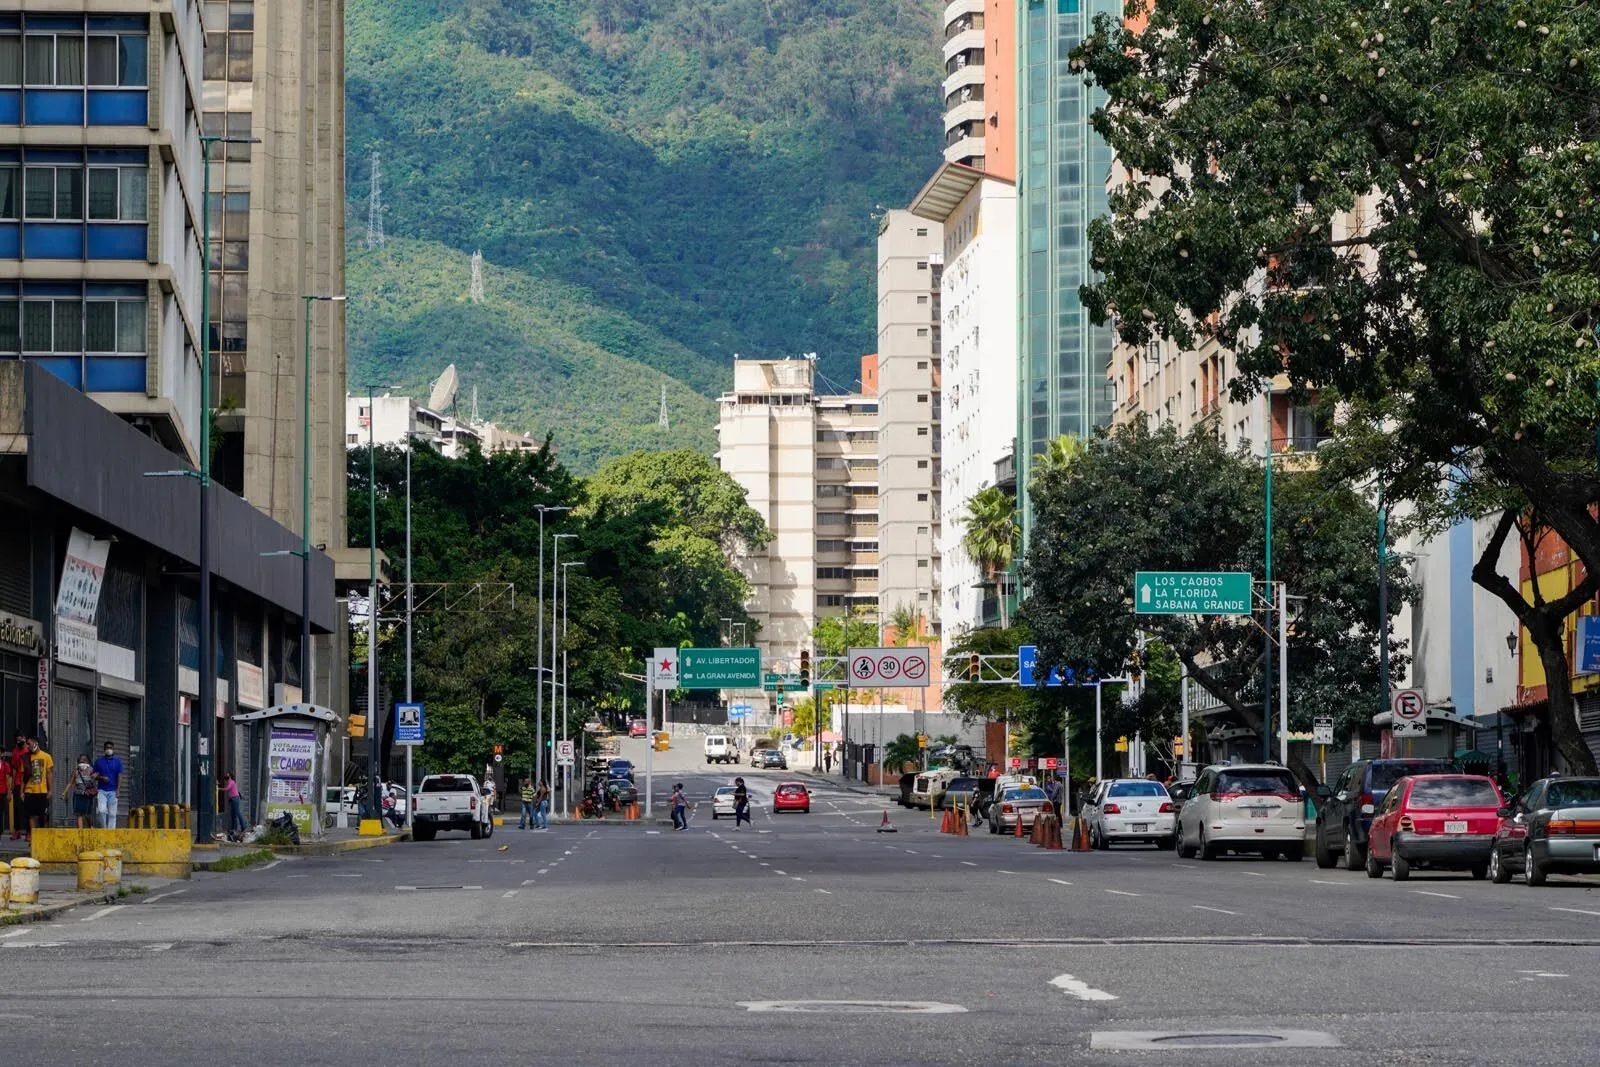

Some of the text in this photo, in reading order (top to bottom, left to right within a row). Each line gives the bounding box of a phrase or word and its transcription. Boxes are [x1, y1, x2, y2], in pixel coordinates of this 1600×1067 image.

[1155, 577, 1223, 586] LOS CAOBOS
[1155, 588, 1218, 598] LA FLORIDA
[1155, 600, 1245, 610] SABANA GRANDE
[708, 657, 755, 665] LIBERTADOR
[882, 661, 895, 670] 30
[706, 672, 727, 680] GRAN
[727, 672, 756, 680] AVENIDA
[494, 745, 503, 753] M
[280, 757, 312, 770] CAMBIO
